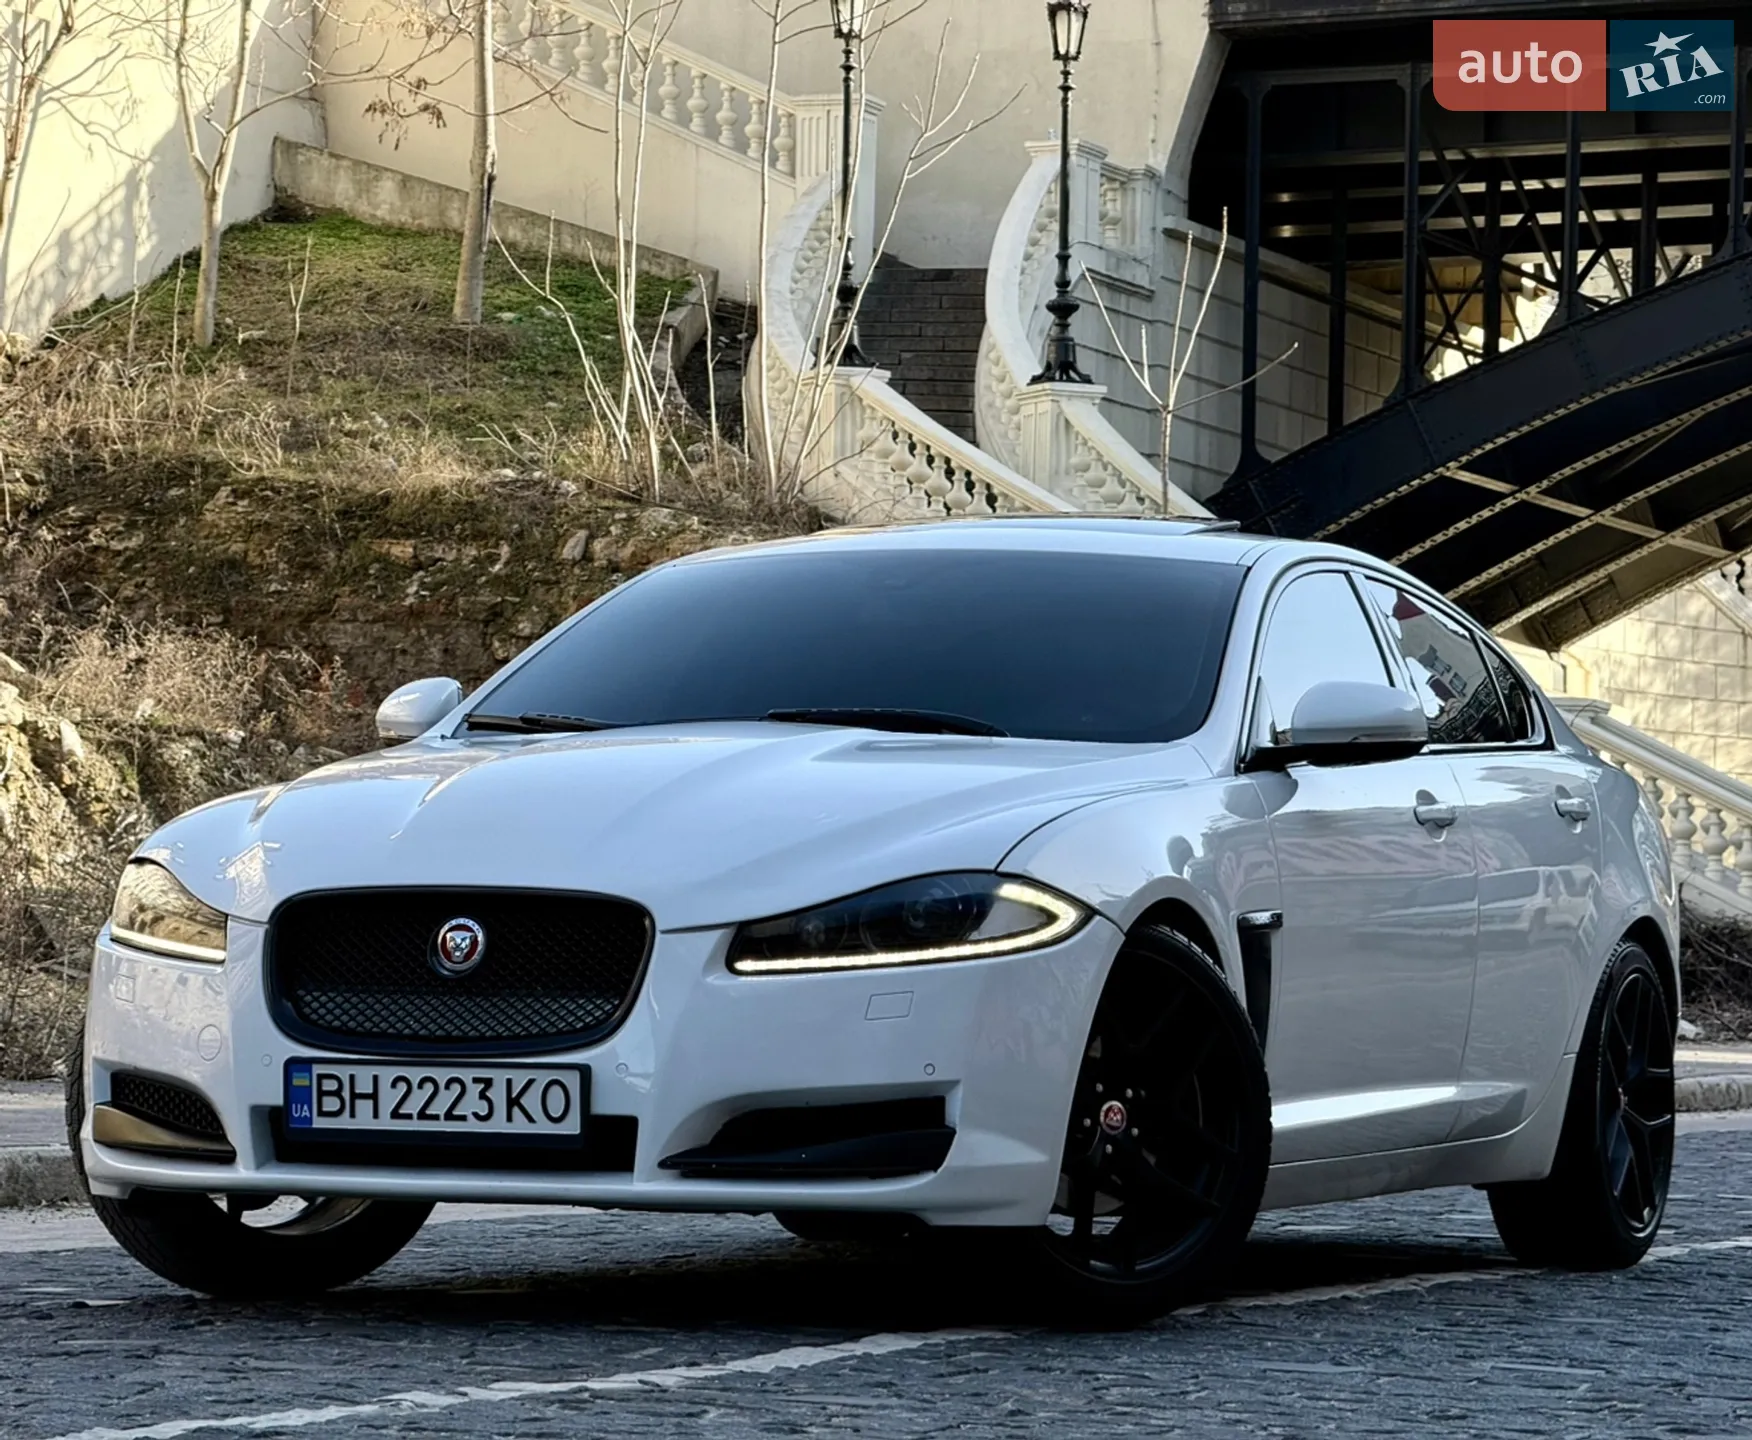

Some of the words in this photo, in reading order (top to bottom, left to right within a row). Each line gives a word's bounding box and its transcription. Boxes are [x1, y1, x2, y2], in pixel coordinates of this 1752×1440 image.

[292, 1103, 310, 1117] UA
[316, 1072, 380, 1119] BH
[389, 1075, 494, 1122] 2223
[505, 1077, 571, 1124] KO
